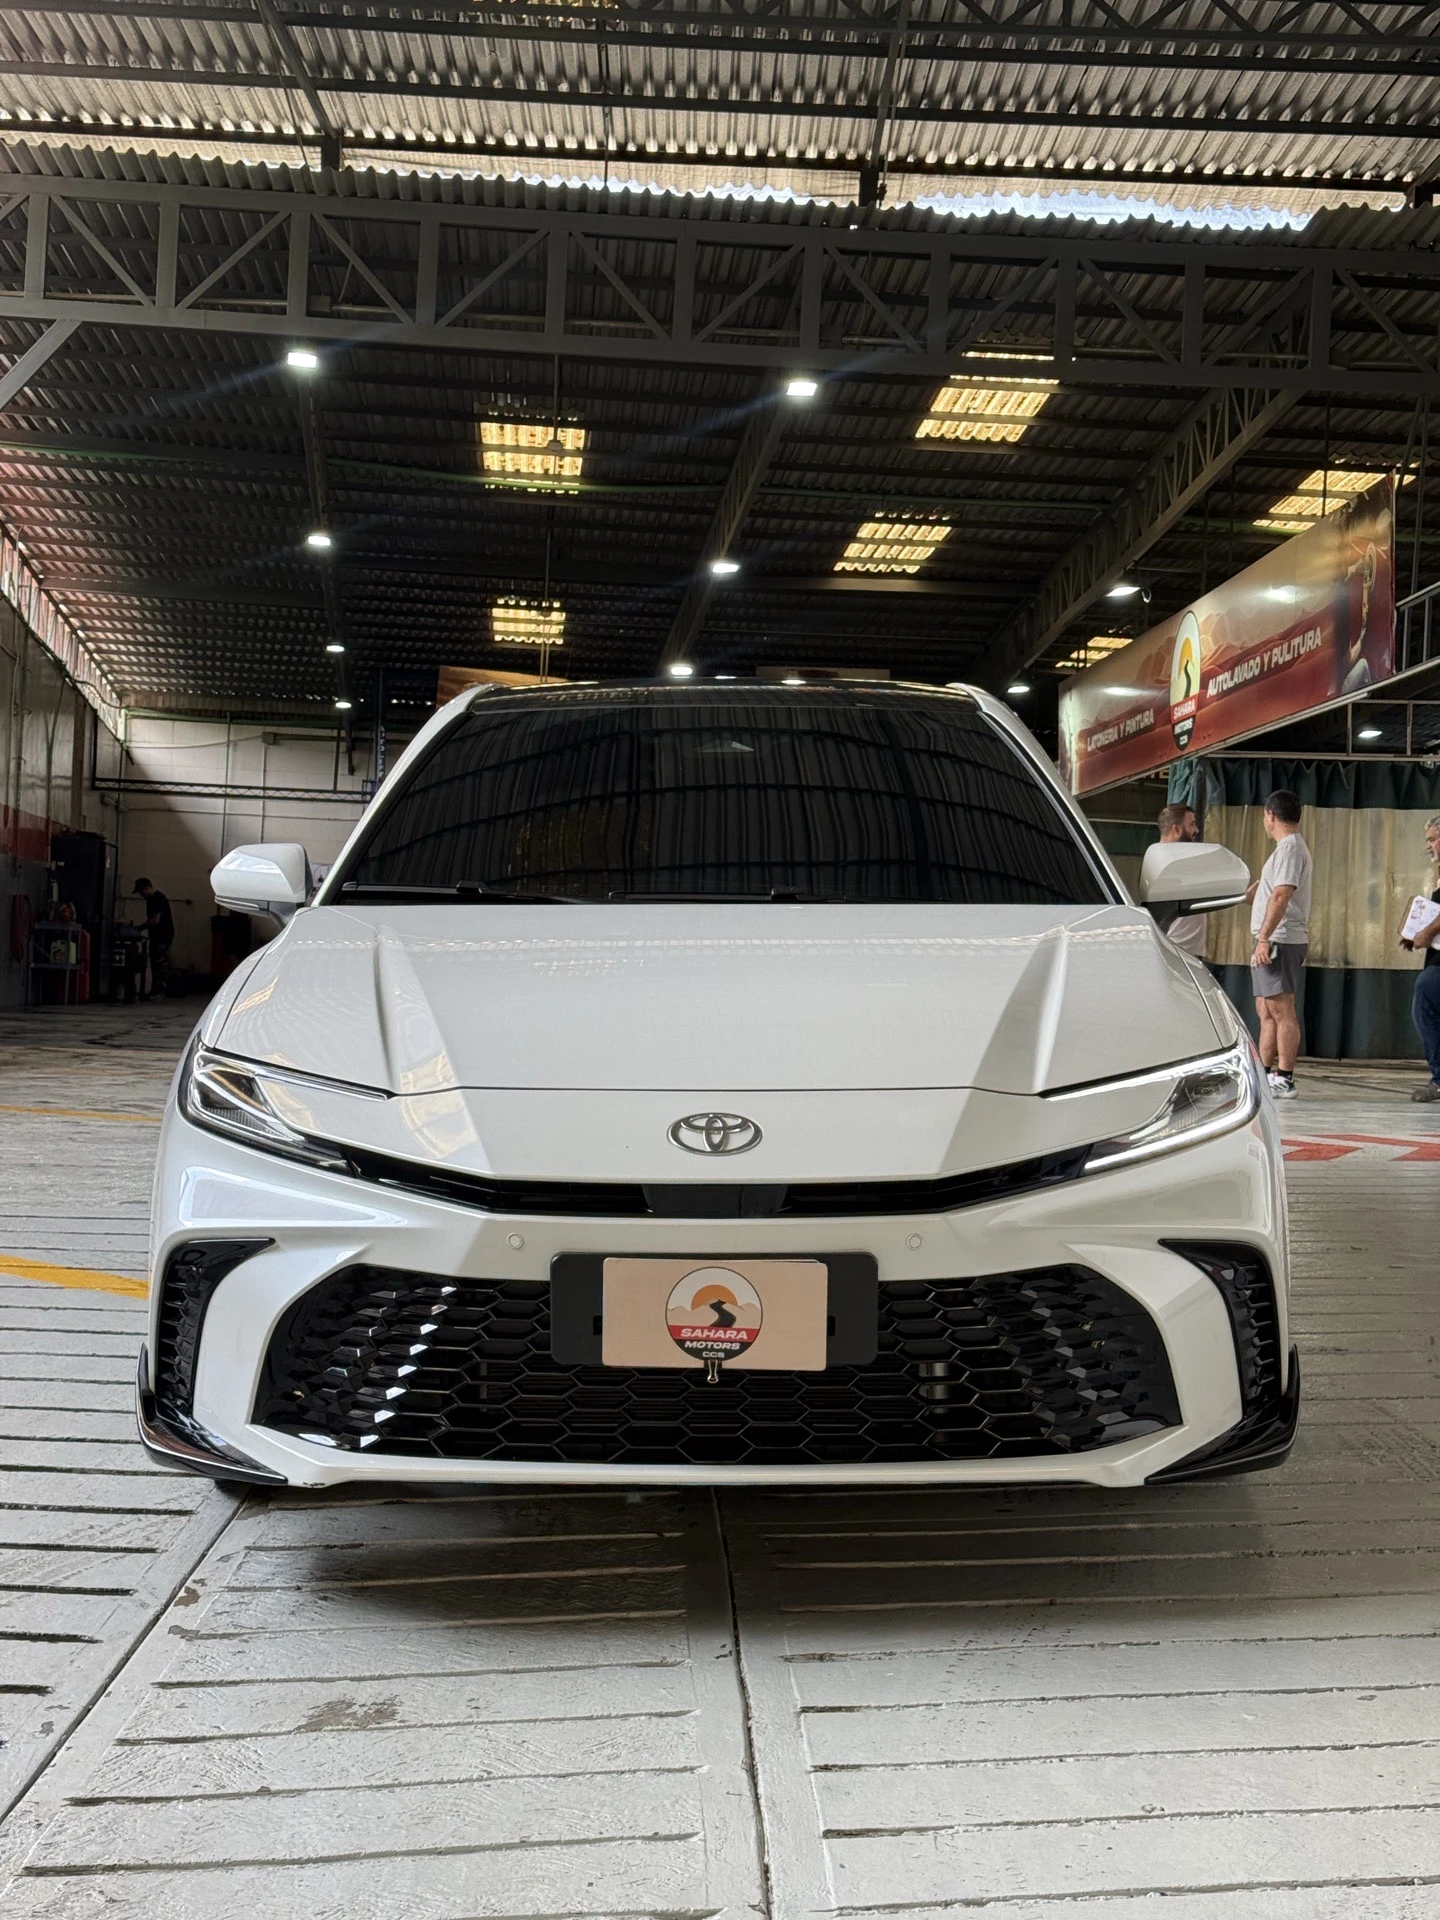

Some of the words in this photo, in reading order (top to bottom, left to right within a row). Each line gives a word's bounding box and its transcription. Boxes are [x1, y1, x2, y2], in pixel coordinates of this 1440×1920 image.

[1206, 655, 1261, 698] AUTOLAVADO
[1263, 650, 1271, 672] Y
[1271, 626, 1322, 668] PULITURA
[1119, 721, 1126, 738] Y
[680, 1328, 748, 1340] SAHARA
[684, 1340, 741, 1350] MOTORS
